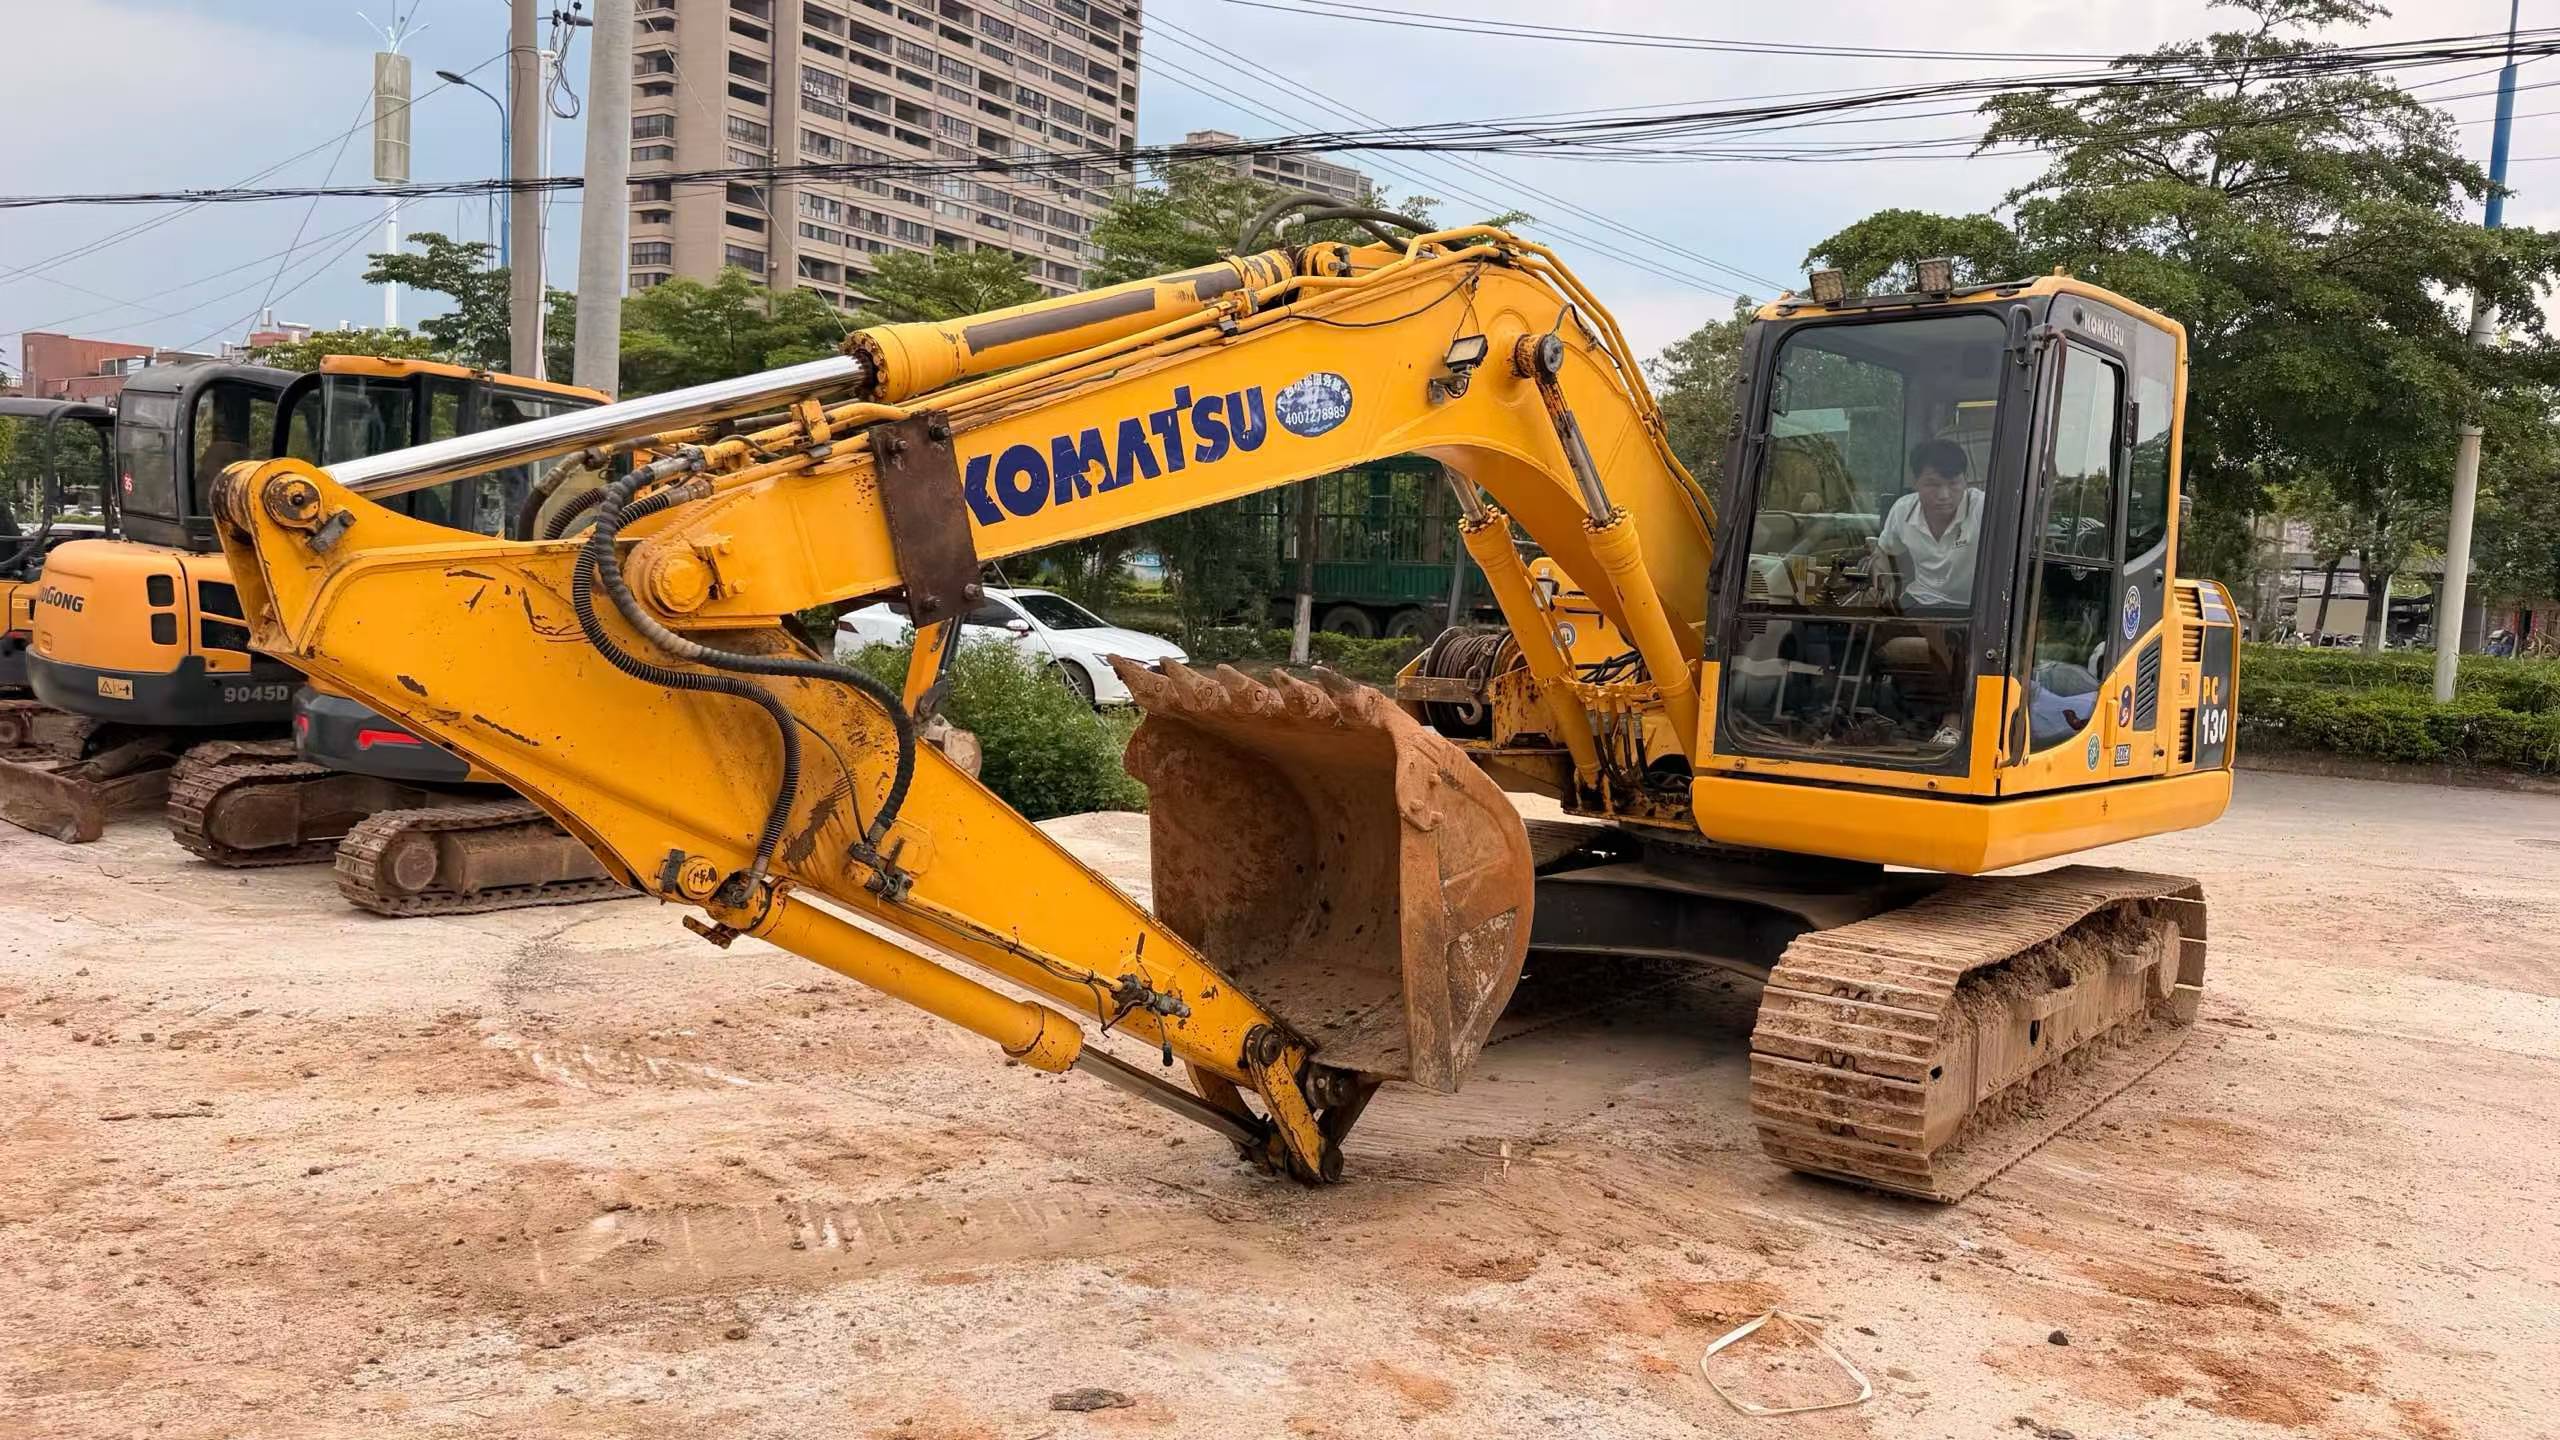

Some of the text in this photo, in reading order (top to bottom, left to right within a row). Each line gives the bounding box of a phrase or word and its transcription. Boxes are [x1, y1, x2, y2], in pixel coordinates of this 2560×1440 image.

[2083, 312, 2124, 346] KOMATSU
[224, 685, 289, 702] 9045D
[2202, 676, 2219, 705] PC
[2202, 708, 2228, 745] 130
